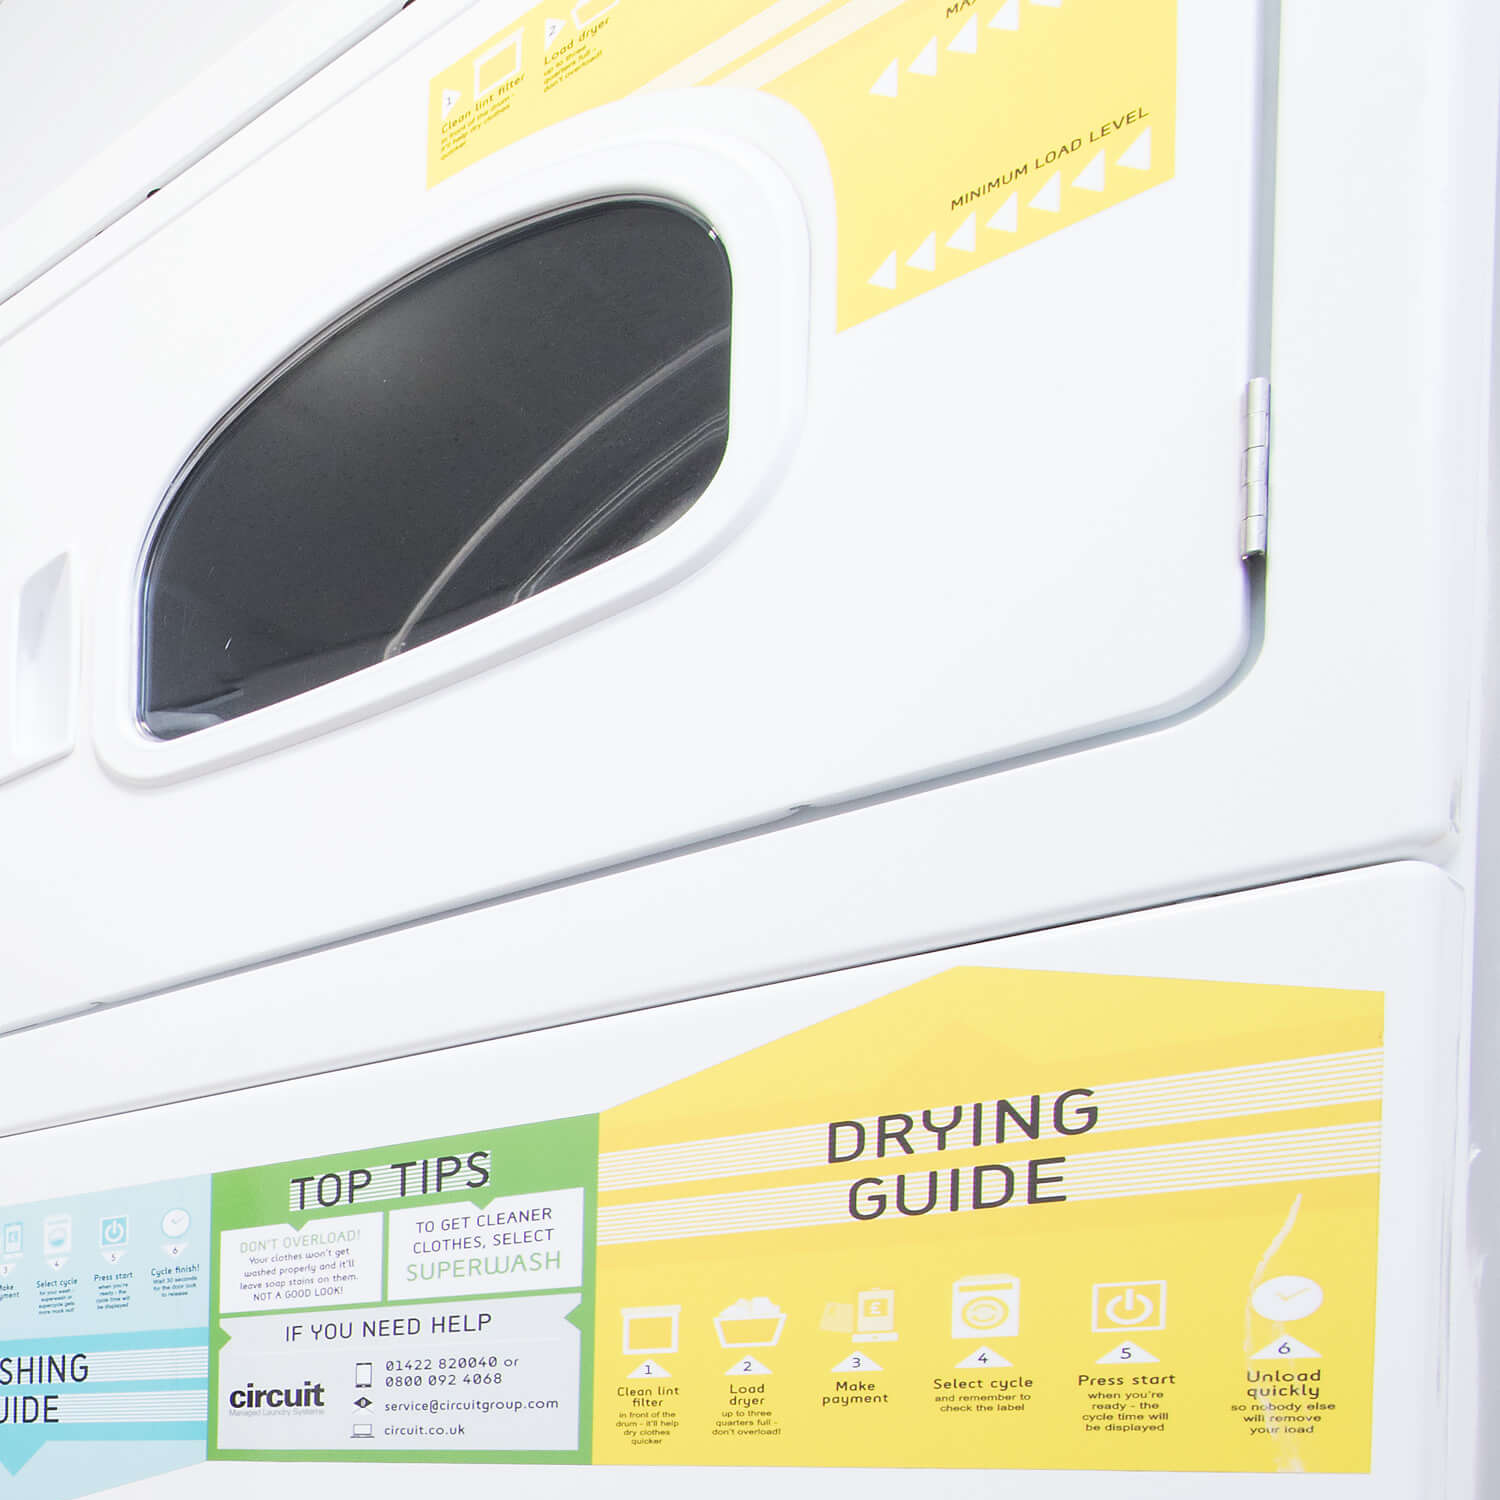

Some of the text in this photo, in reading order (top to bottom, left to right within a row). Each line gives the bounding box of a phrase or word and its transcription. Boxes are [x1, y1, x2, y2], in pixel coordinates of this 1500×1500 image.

[951, 107, 1149, 211] MINIMUM LOAD LEVEL
[828, 1087, 1099, 1164] DRYING
[291, 1151, 490, 1210] TOP TIPS
[849, 1156, 1068, 1222] GUIDE
[417, 1208, 552, 1234] TO GET CLEANER
[240, 1229, 361, 1253] DON'T OVERLOAD!
[413, 1228, 554, 1254] CLOTHES, SELECT
[407, 1250, 561, 1281] SUPERWASH
[286, 1313, 491, 1342] IF YOU NEED HELP
[386, 1357, 519, 1371] 01422 820040 or
[386, 1373, 502, 1387] 0800 092 4068
[934, 1376, 1033, 1390] Select cycle
[1078, 1373, 1176, 1386] Press start
[1247, 1370, 1321, 1383] Unload
[618, 1386, 679, 1397] Clean lint
[730, 1384, 765, 1394] Load
[836, 1381, 875, 1391] Make
[1247, 1385, 1320, 1400] quickly
[230, 1381, 325, 1409] circuit
[632, 1397, 663, 1407] filter
[729, 1396, 764, 1408] dryer
[823, 1393, 888, 1406] payment
[385, 1397, 558, 1413] service@circuitgroup.com
[384, 1424, 464, 1436] circuit.co.uk
